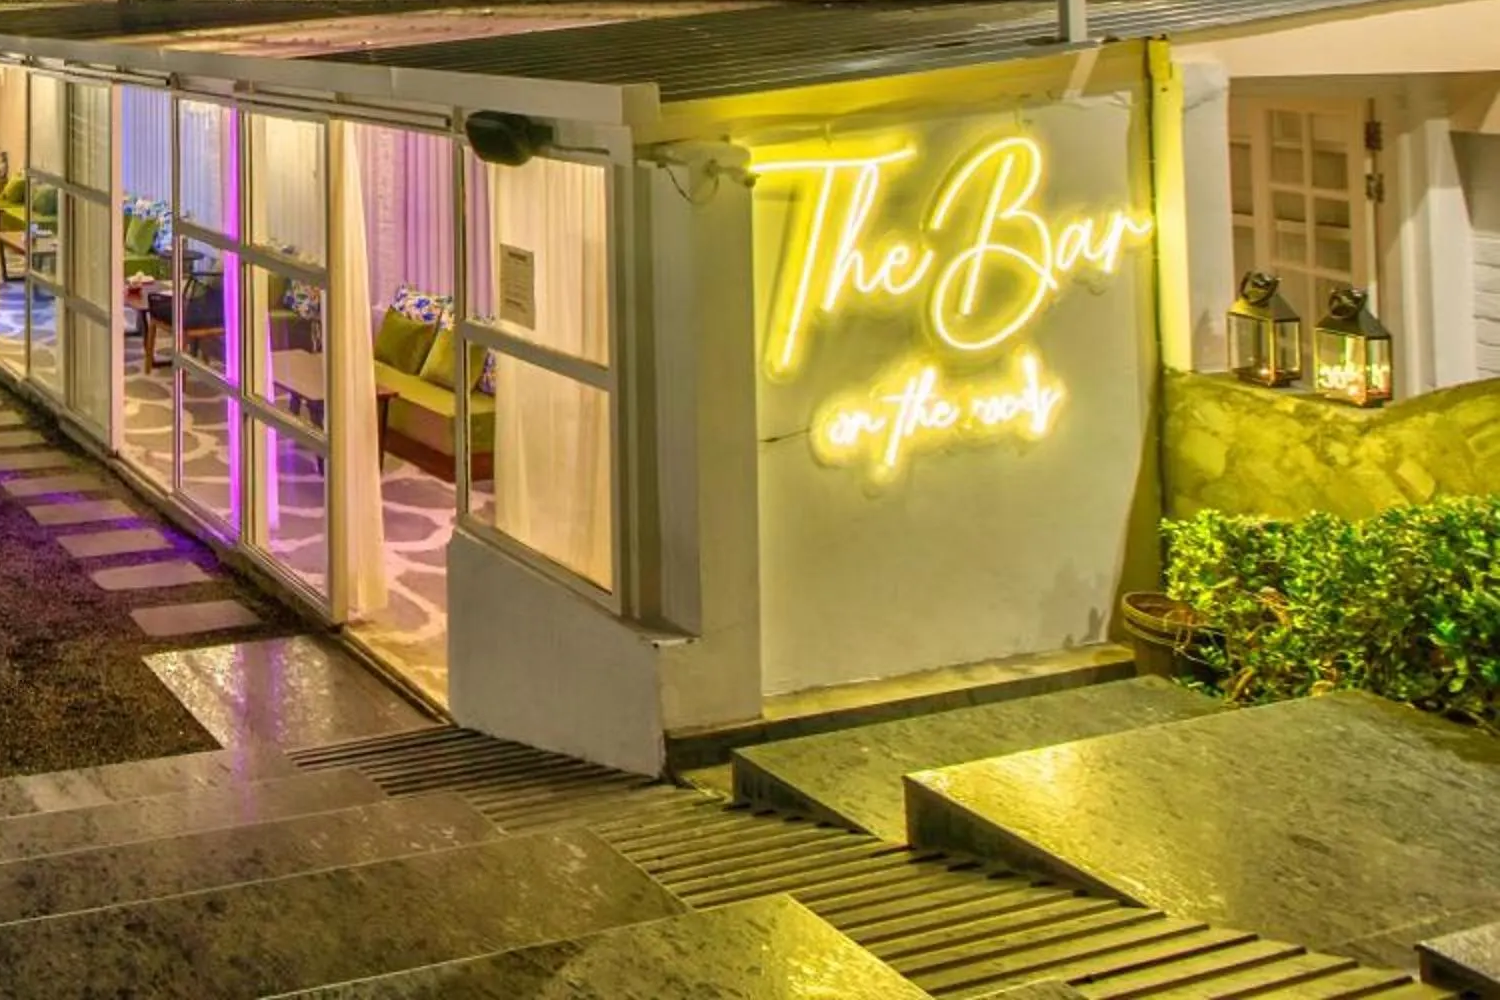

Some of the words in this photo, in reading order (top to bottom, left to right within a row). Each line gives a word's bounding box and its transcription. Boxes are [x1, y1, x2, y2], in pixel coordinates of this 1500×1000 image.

[748, 146, 935, 369] The
[931, 135, 1153, 351] Bar
[828, 408, 887, 447] on
[881, 367, 960, 467] the
